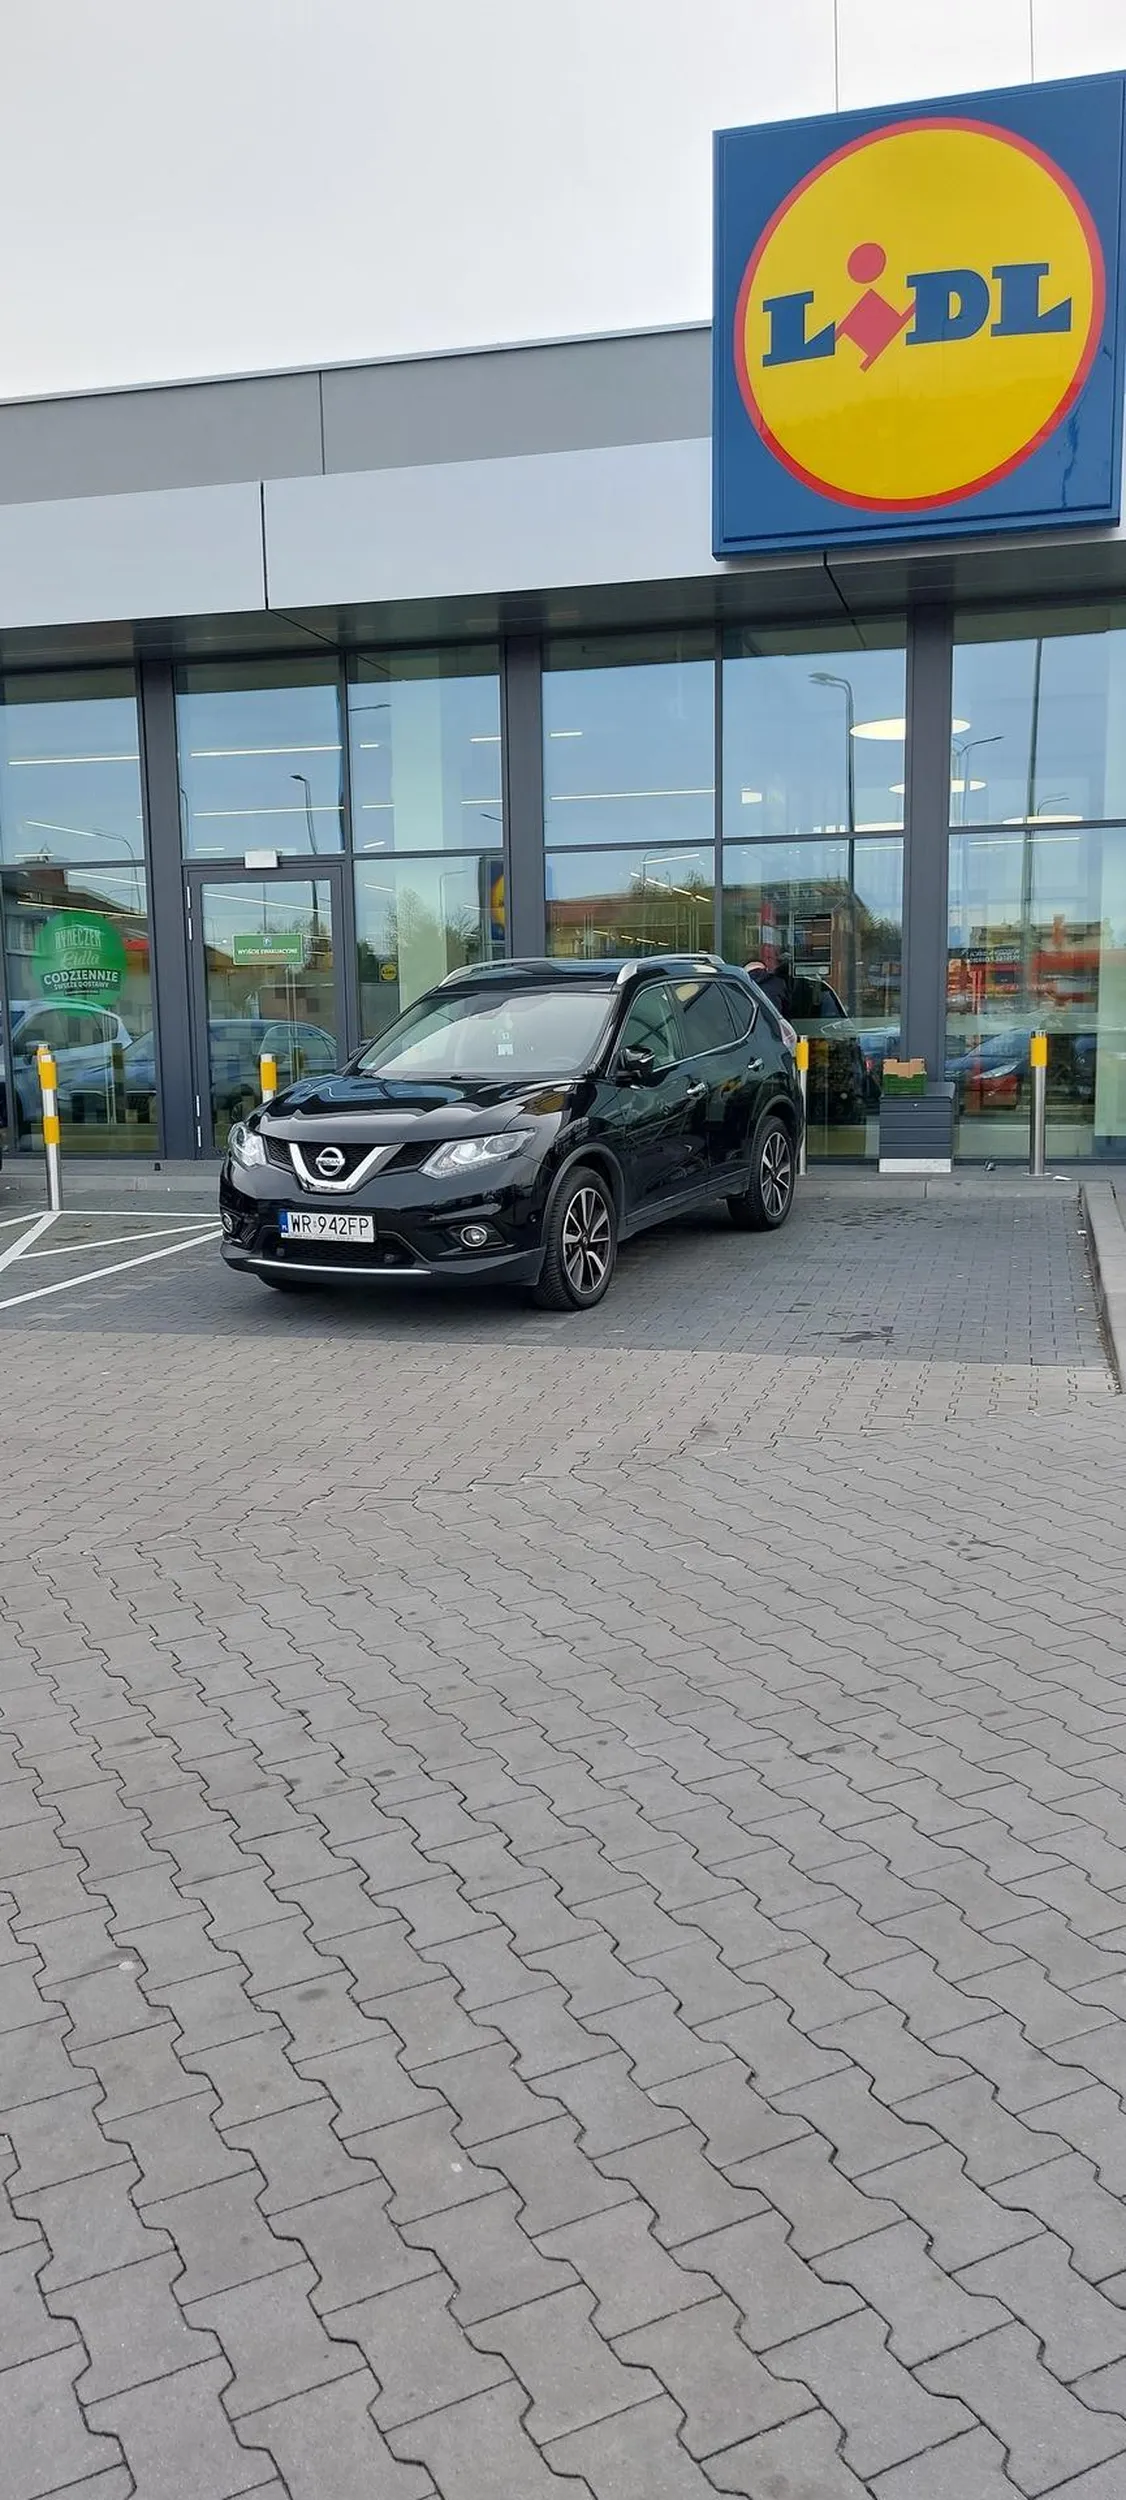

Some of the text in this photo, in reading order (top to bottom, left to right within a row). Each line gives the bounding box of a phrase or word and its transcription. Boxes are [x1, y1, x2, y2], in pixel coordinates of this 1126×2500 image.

[43, 969, 119, 985] CODZIENNIE
[291, 1214, 369, 1235] WR 942FP
